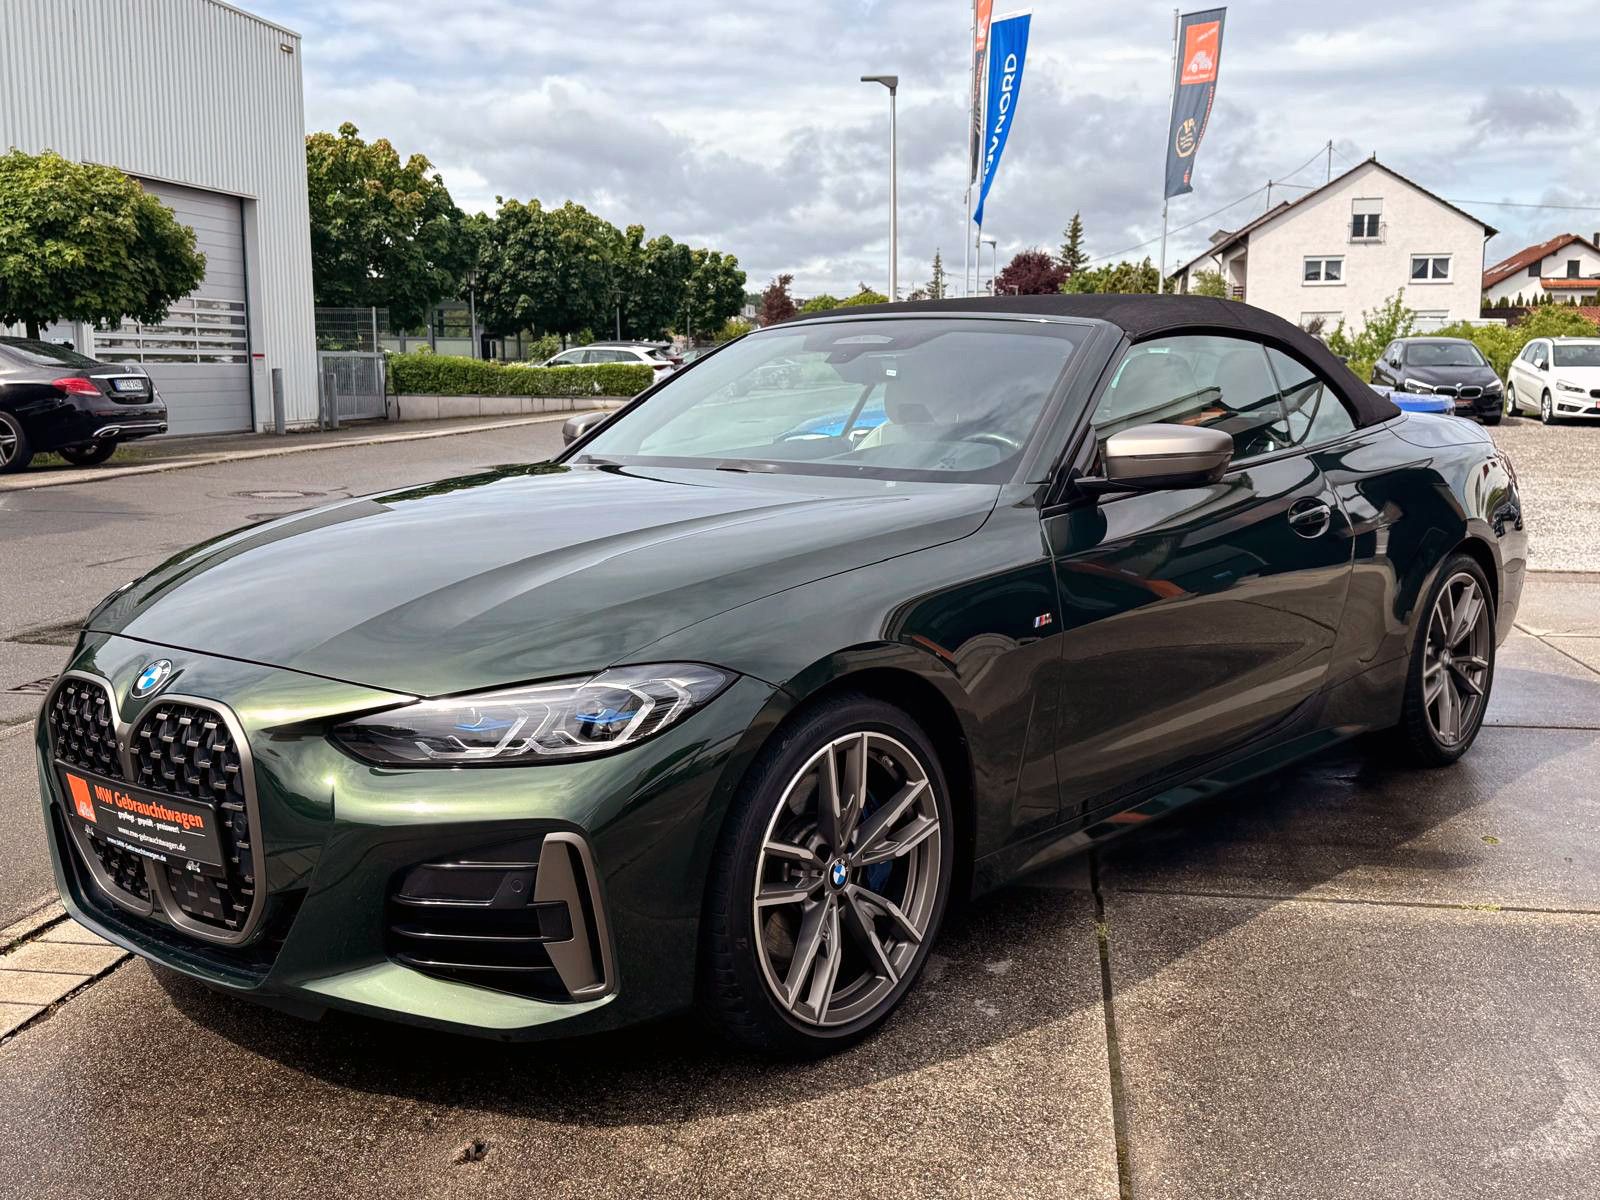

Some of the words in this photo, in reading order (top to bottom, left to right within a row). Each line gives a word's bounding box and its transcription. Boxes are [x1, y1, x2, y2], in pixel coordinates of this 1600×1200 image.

[994, 53, 1017, 134] NORD
[94, 785, 113, 805] MW
[114, 791, 204, 829] Gebrauchtwagen
